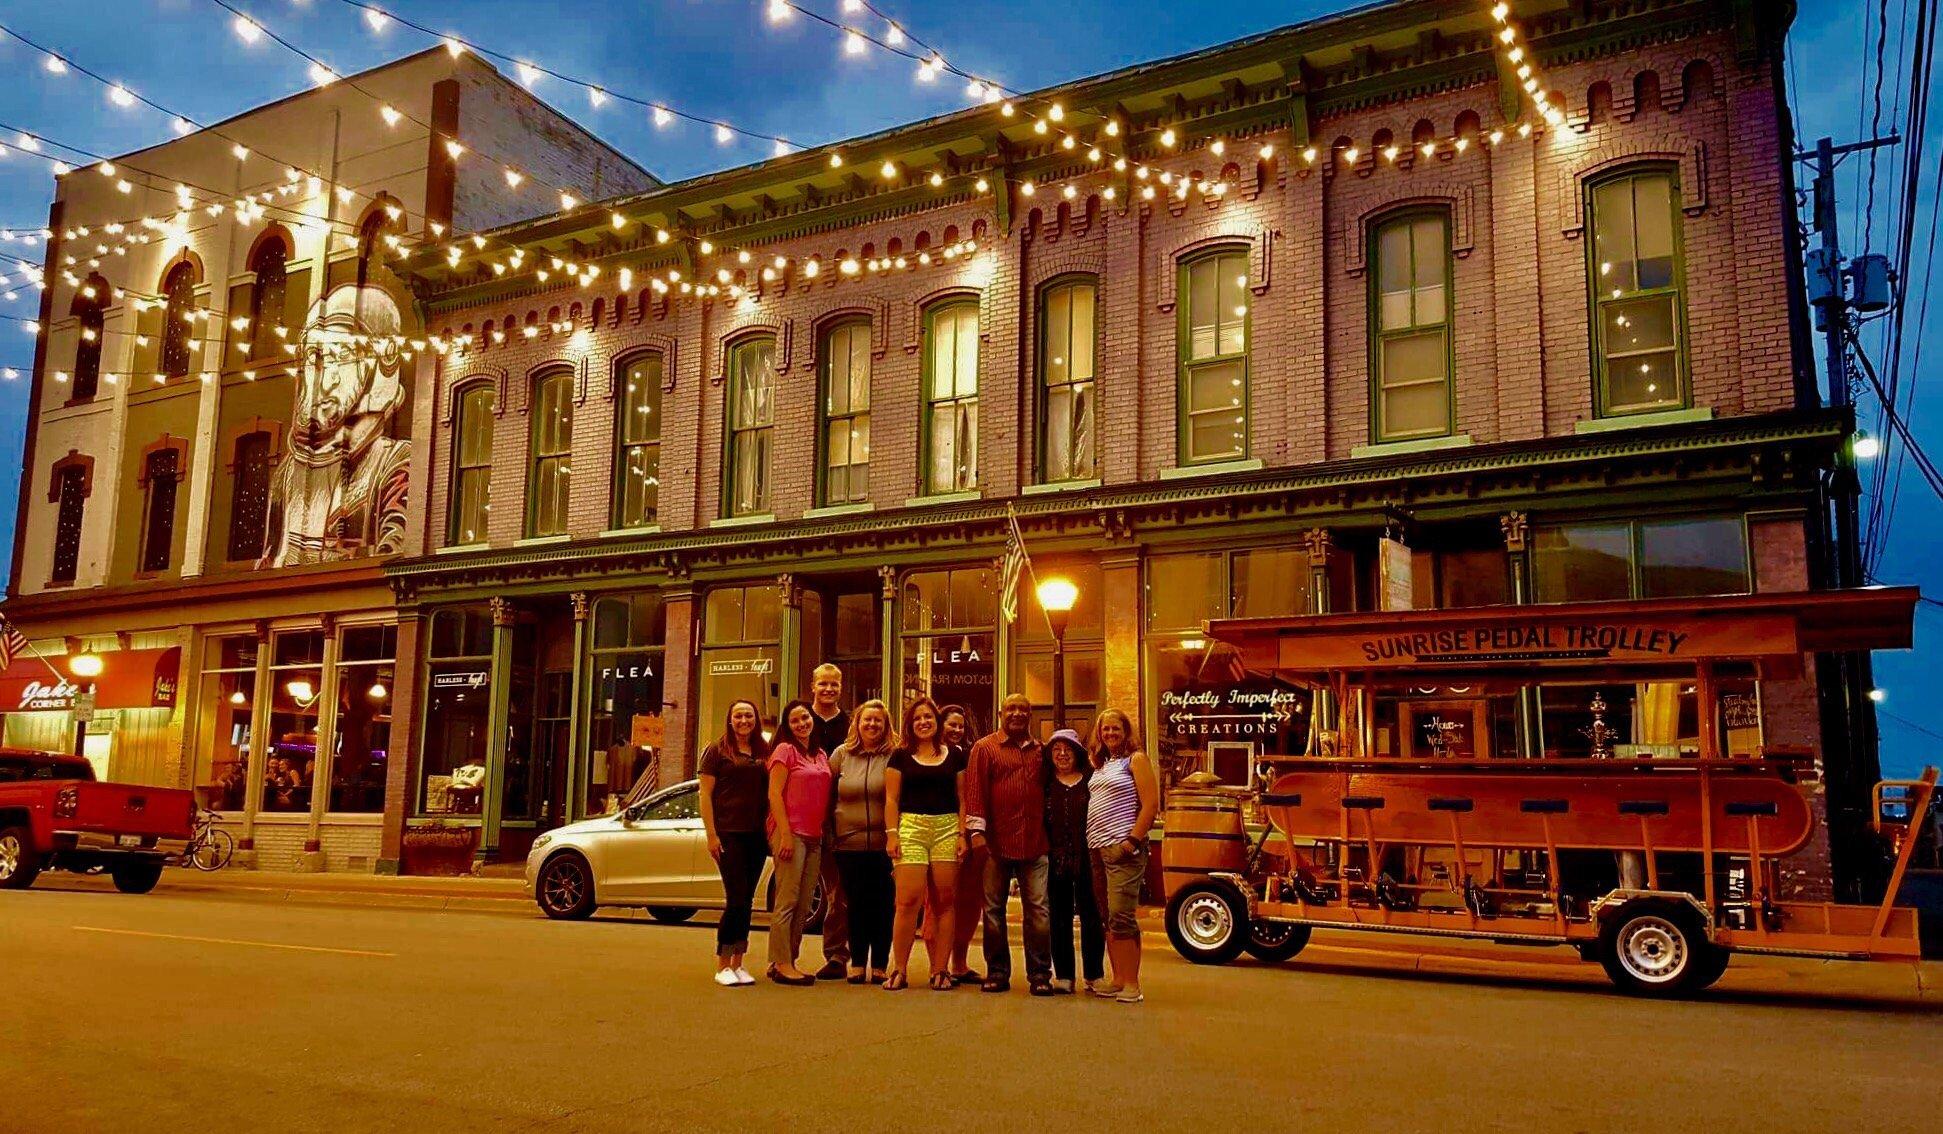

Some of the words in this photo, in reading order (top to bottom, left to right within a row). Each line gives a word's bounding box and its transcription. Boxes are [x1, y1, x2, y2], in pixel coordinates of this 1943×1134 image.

[1361, 630, 1469, 661] SUNRISE
[1475, 626, 1557, 649] PEDAL
[1565, 625, 1689, 654] TROLLEY
[917, 650, 980, 664] FLEA
[602, 665, 654, 679] FLEA
[1161, 691, 1220, 709] Perfectly
[1228, 689, 1297, 708] Imperfect
[1177, 724, 1277, 734] CREATIONS
